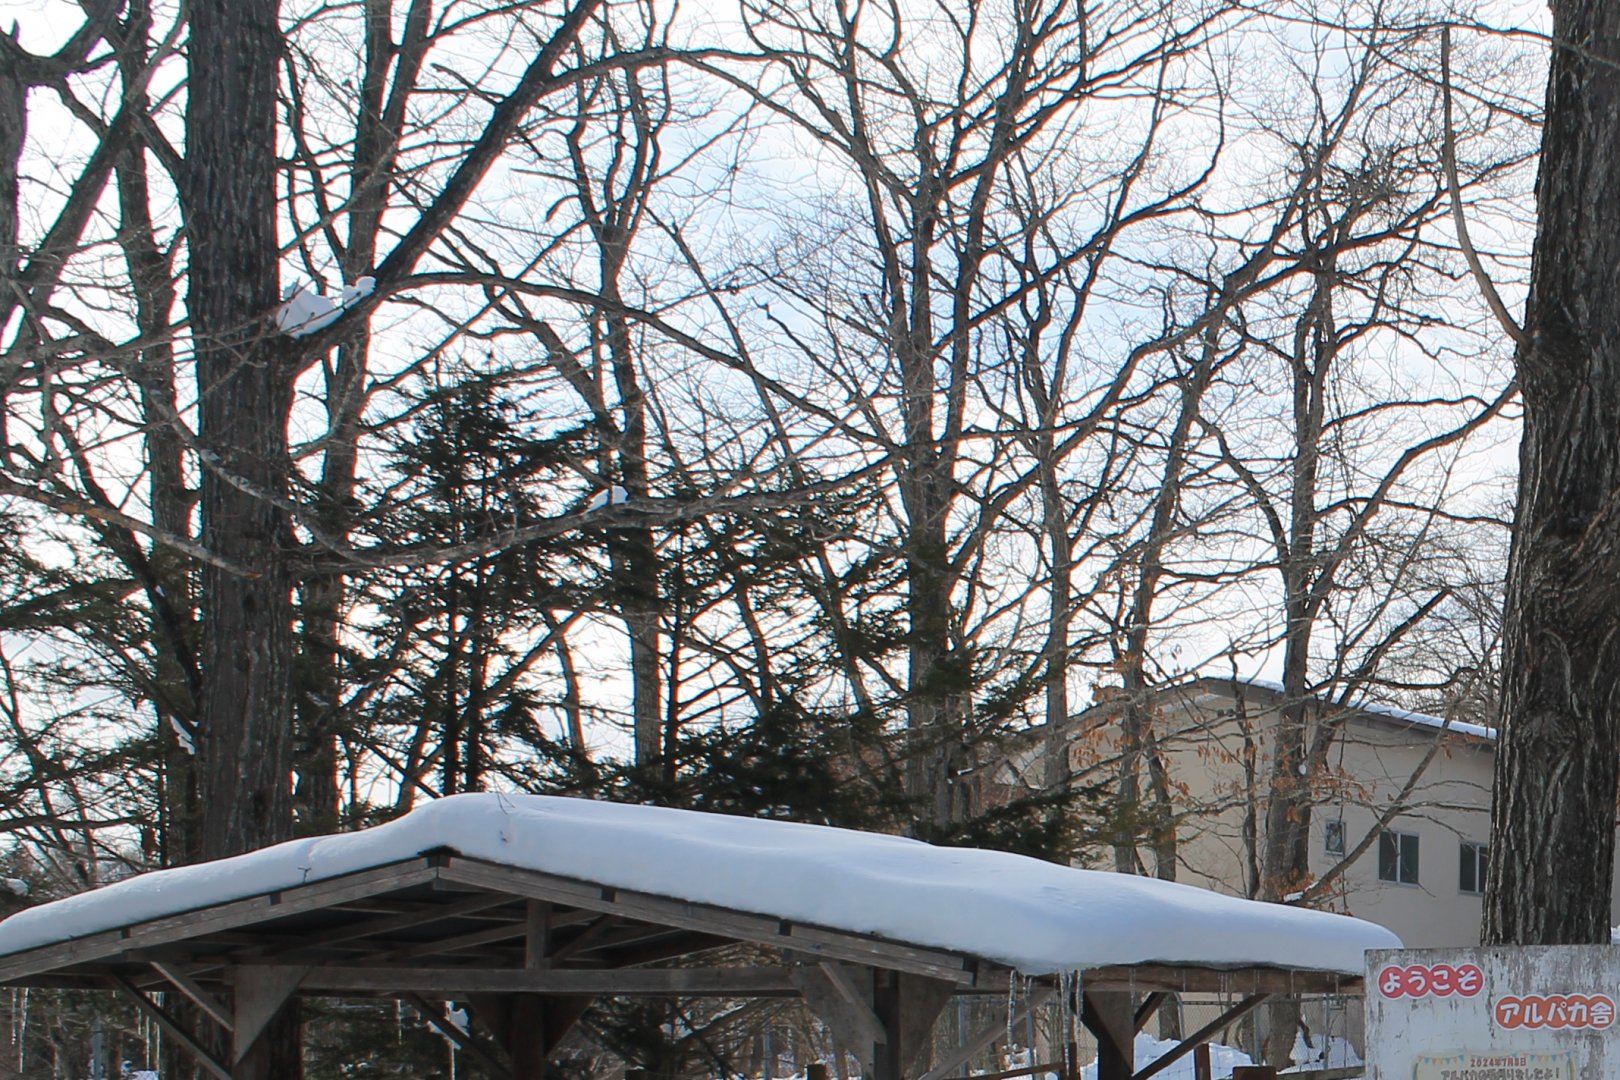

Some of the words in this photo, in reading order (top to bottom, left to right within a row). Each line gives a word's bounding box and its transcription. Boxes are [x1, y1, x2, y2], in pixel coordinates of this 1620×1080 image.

[1381, 969, 1478, 994] ようこそ
[1500, 1001, 1613, 1025] アルパカ舎
